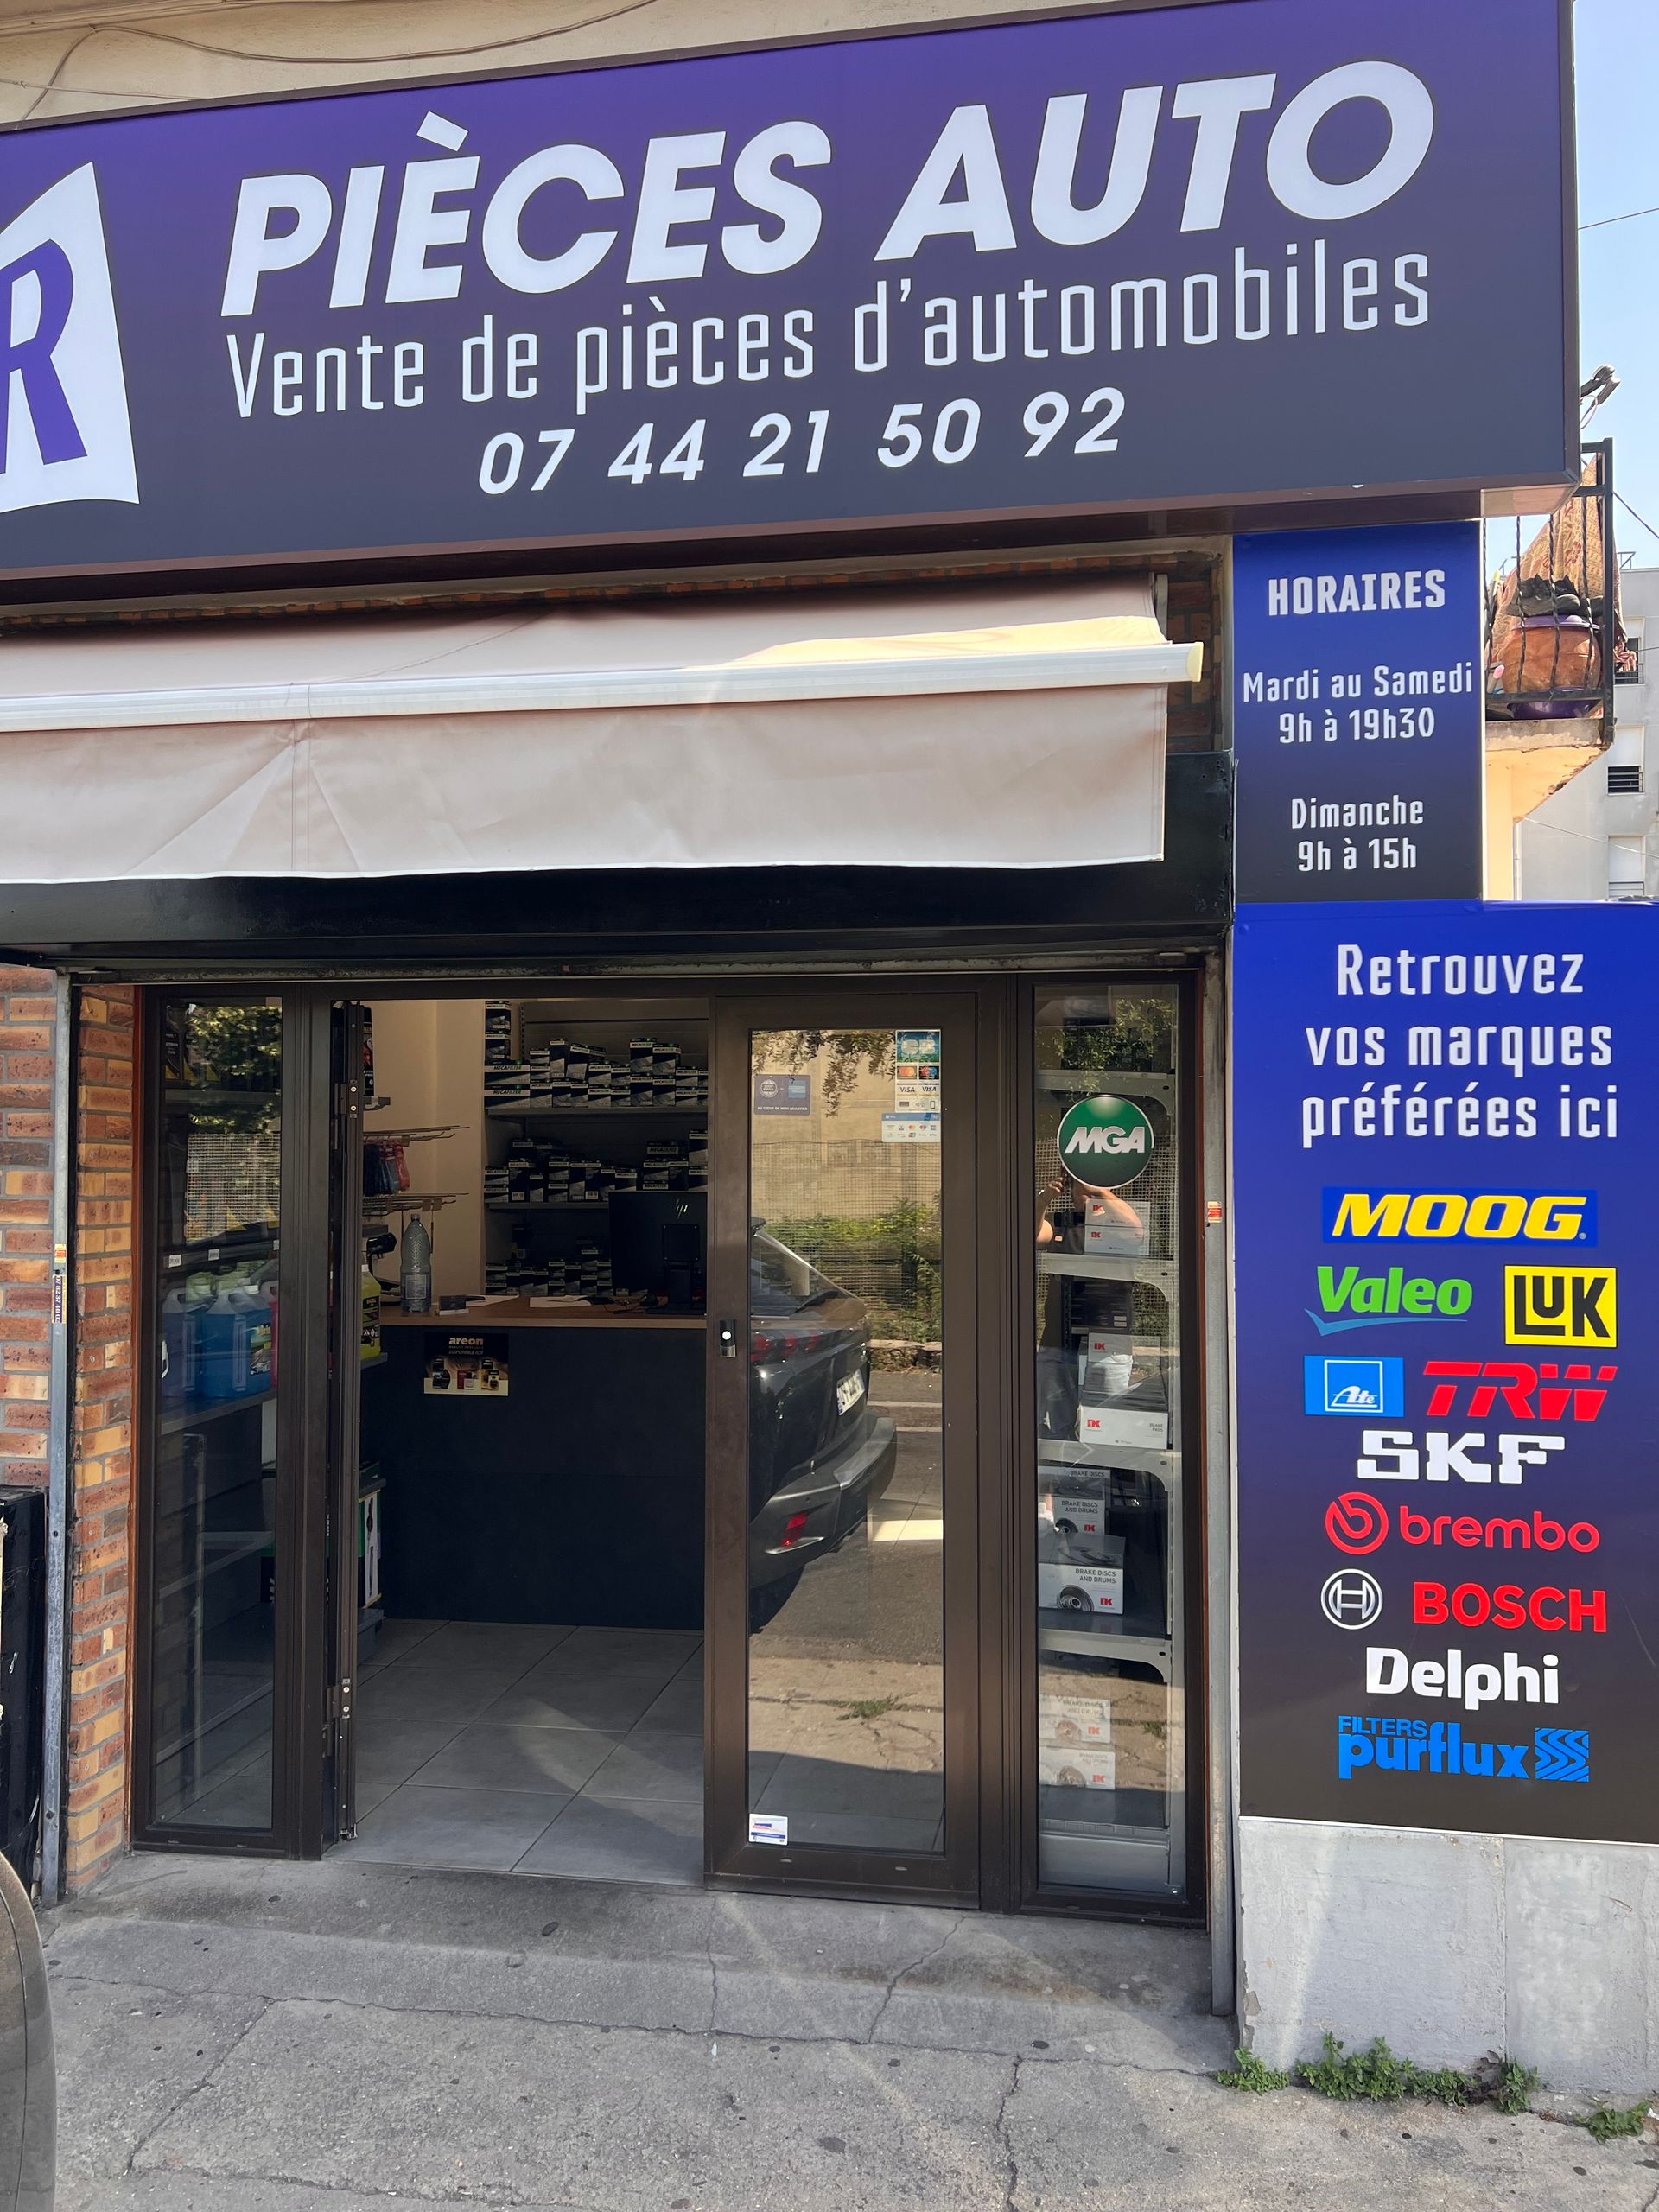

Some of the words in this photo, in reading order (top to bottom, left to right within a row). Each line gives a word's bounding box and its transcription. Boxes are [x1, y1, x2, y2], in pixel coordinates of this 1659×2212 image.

[220, 111, 832, 317] PIÈCES
[874, 60, 1434, 261] AUTO
[226, 333, 424, 418] Vente
[462, 315, 538, 404] de
[576, 296, 814, 415] pièces
[479, 429, 575, 495] 07
[607, 419, 706, 485] 44
[742, 410, 830, 477] 21
[876, 397, 982, 468] 50
[1023, 386, 1125, 457] 92
[1268, 569, 1446, 616] HORAIRES
[1243, 669, 1319, 702] Mardi
[1331, 674, 1362, 698] au
[1374, 662, 1472, 696] Samedi
[1279, 711, 1312, 744] 9h
[1324, 709, 1338, 742] à
[1349, 707, 1435, 741] 19h30
[1292, 795, 1424, 829] Dimanche
[1298, 841, 1331, 872] 9h
[1344, 839, 1357, 870] à
[1368, 837, 1416, 869] 15h
[1337, 944, 1584, 995] Retrouvez
[1305, 1026, 1386, 1066] vos
[1408, 1025, 1612, 1077] marques
[1302, 1081, 1537, 1148] préférées
[1560, 1084, 1618, 1138] ici
[1064, 1126, 1146, 1154] MGA
[1332, 1193, 1587, 1241] MOOG
[1317, 1265, 1472, 1315] Valeo
[448, 1337, 485, 1345] areon
[1423, 1361, 1618, 1421] TRW
[1357, 1429, 1565, 1484] SKF
[1399, 1505, 1600, 1553] brembo
[1413, 1581, 1607, 1633] BOSCH
[1365, 1646, 1560, 1710] Delphi
[1338, 1715, 1427, 1737] FILTERS
[1338, 1722, 1529, 1780] purflux
